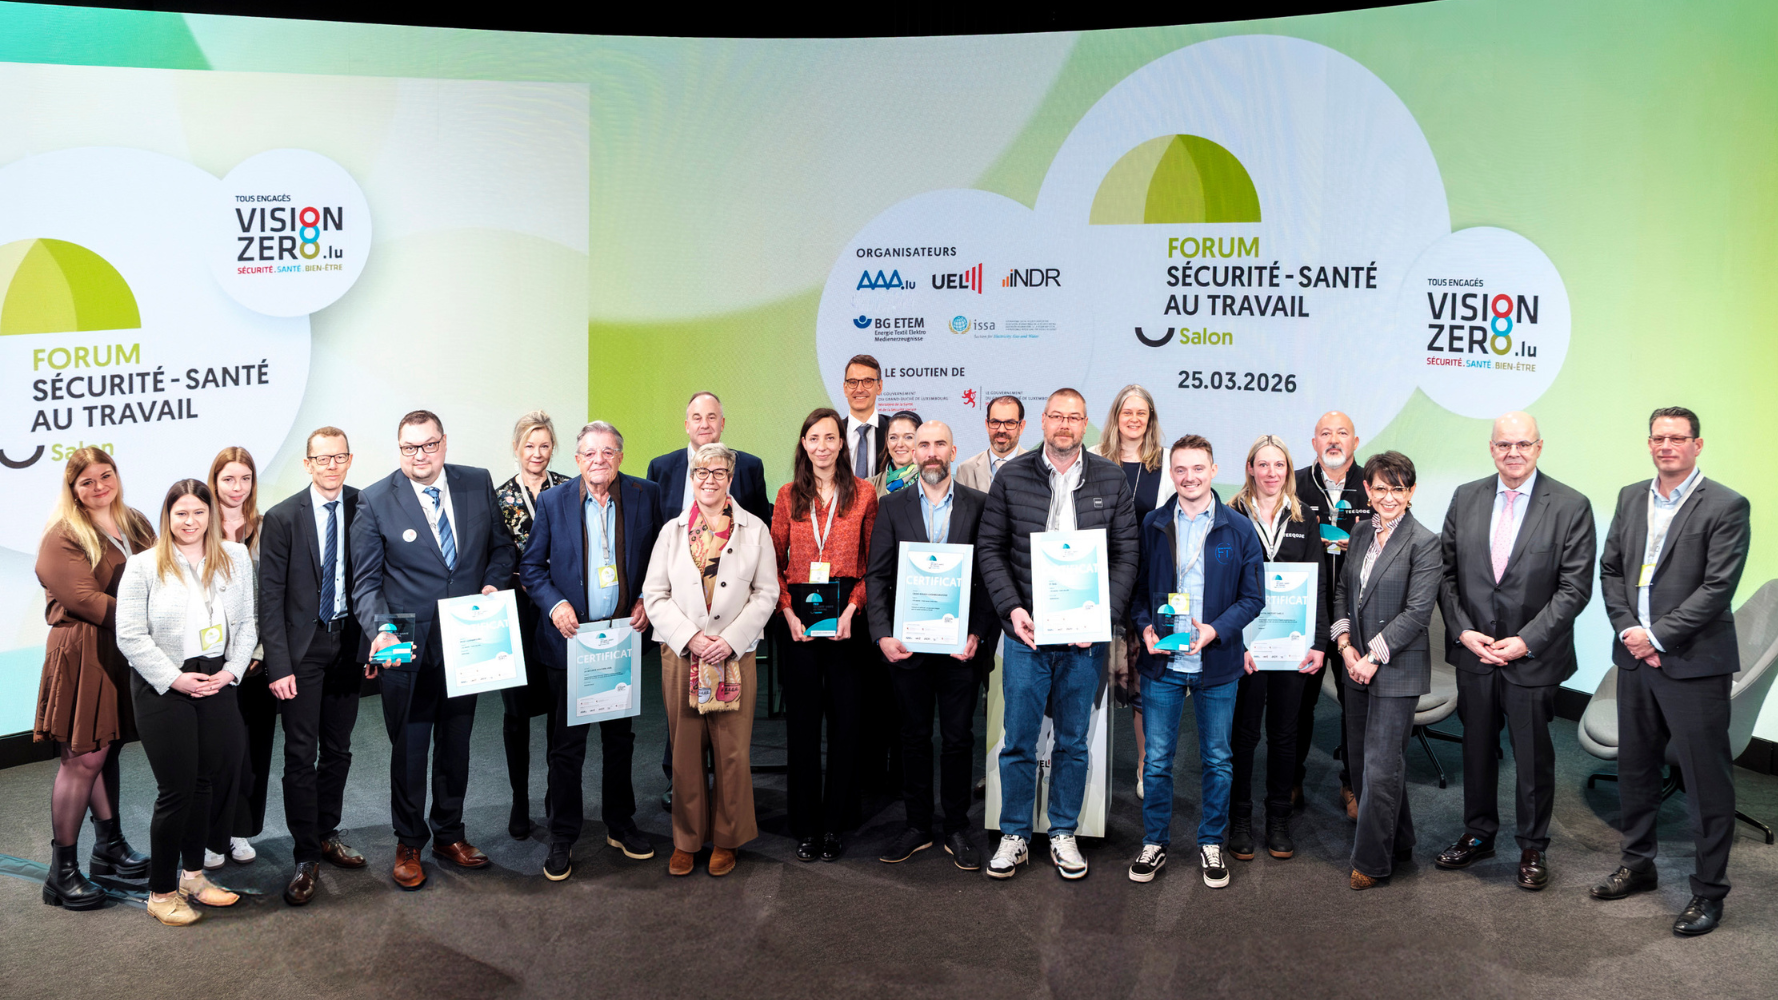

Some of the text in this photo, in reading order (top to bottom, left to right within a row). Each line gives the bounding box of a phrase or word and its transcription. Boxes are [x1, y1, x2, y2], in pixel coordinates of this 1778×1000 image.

[256, 194, 291, 202] ENGAGÉS
[235, 206, 343, 233] VISION
[856, 247, 957, 258] ORGANISATEURS
[1168, 237, 1260, 258] FORUM
[932, 273, 969, 289] UEL
[1427, 278, 1484, 287] TOUS ENGAGÉS
[1164, 294, 1310, 317] AU TRAVAIL
[1427, 292, 1539, 324] VISION
[875, 317, 925, 329] BG ETEM
[973, 319, 996, 330] issa
[1179, 327, 1233, 345] Salon
[33, 343, 140, 371] FORUM
[885, 367, 965, 377] LE SOUTIEN DE
[1178, 370, 1297, 393] 25.03.2026
[30, 398, 198, 433] AU TRAVAIL
[51, 441, 114, 461] San
[906, 575, 962, 588] CERTIFICAT
[1266, 595, 1308, 606] RTIFICAT
[577, 648, 632, 664] CERTIFICAT
